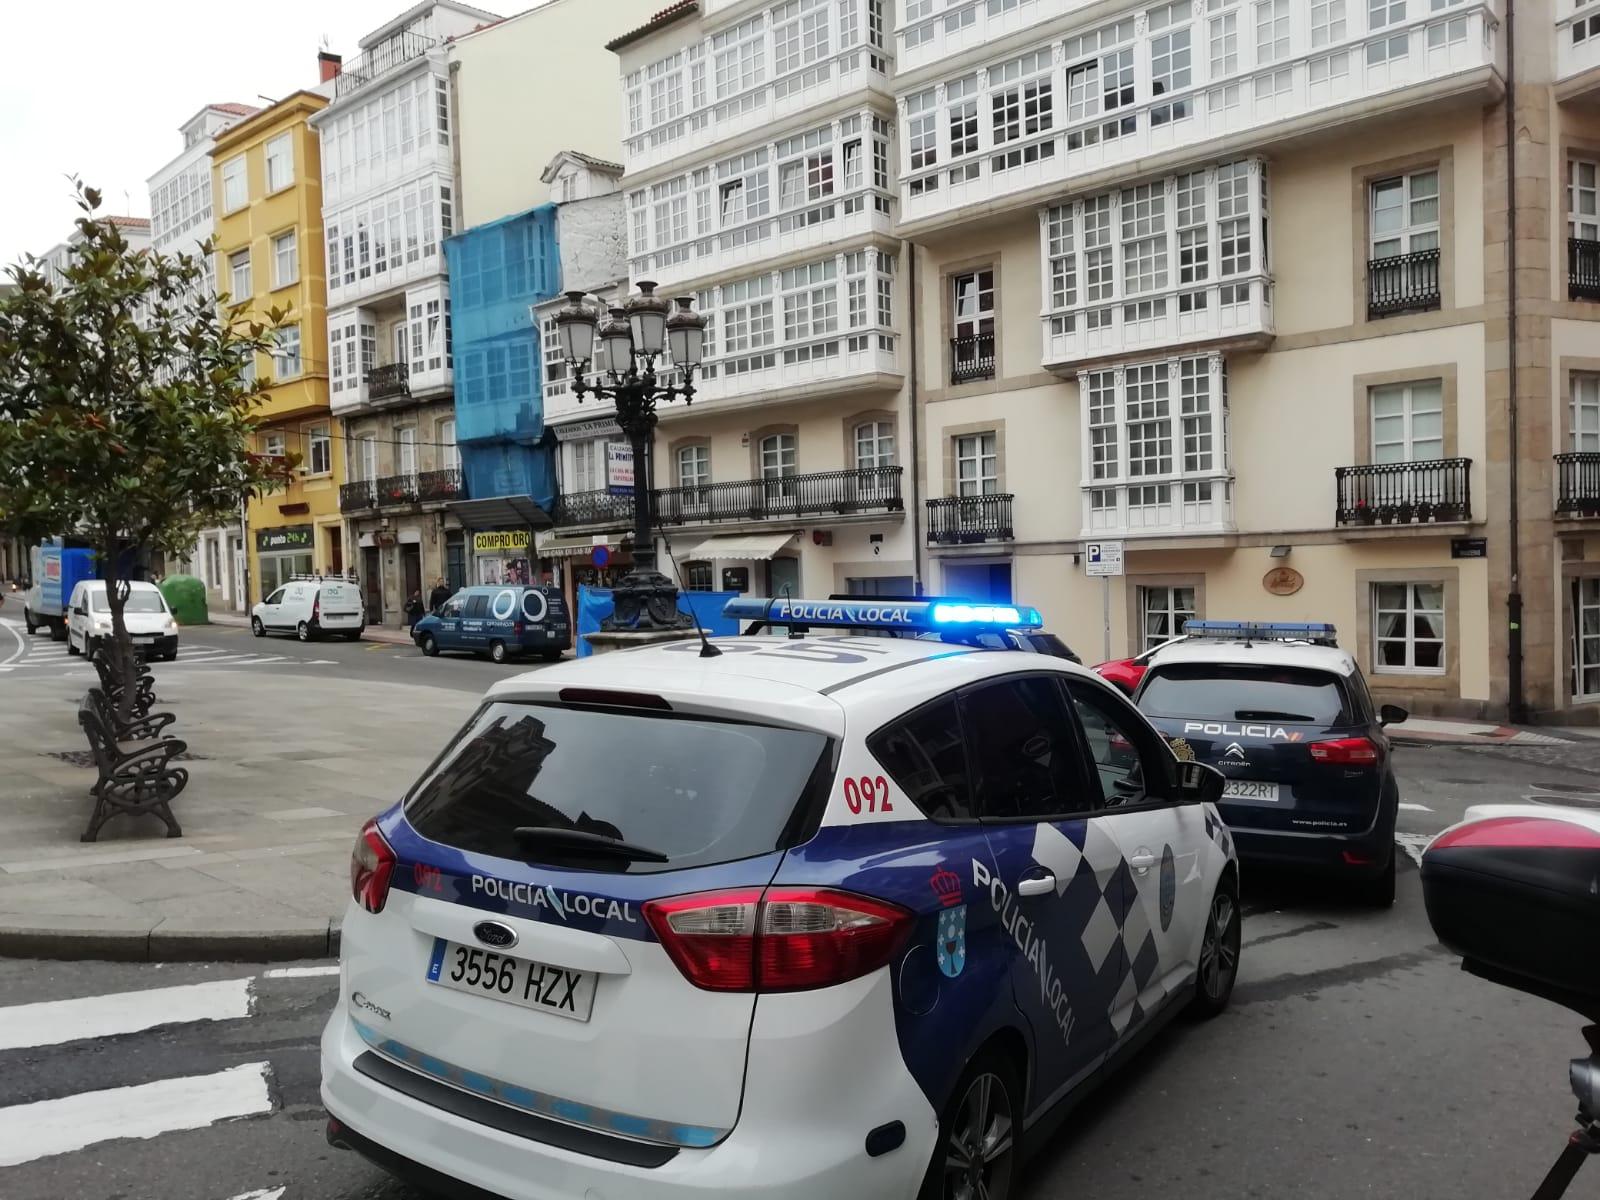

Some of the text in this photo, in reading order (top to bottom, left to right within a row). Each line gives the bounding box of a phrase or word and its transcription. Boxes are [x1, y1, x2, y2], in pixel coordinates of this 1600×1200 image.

[476, 533, 531, 549] COMPRO ORO
[1088, 545, 1100, 562] P
[859, 608, 912, 622] LOCAL
[843, 775, 894, 815] 092
[413, 862, 444, 893] 092
[472, 874, 638, 923] POLICÍA LOCAL
[450, 946, 582, 1012] 3556 HZX
[1045, 965, 1076, 1047] LOCAL
